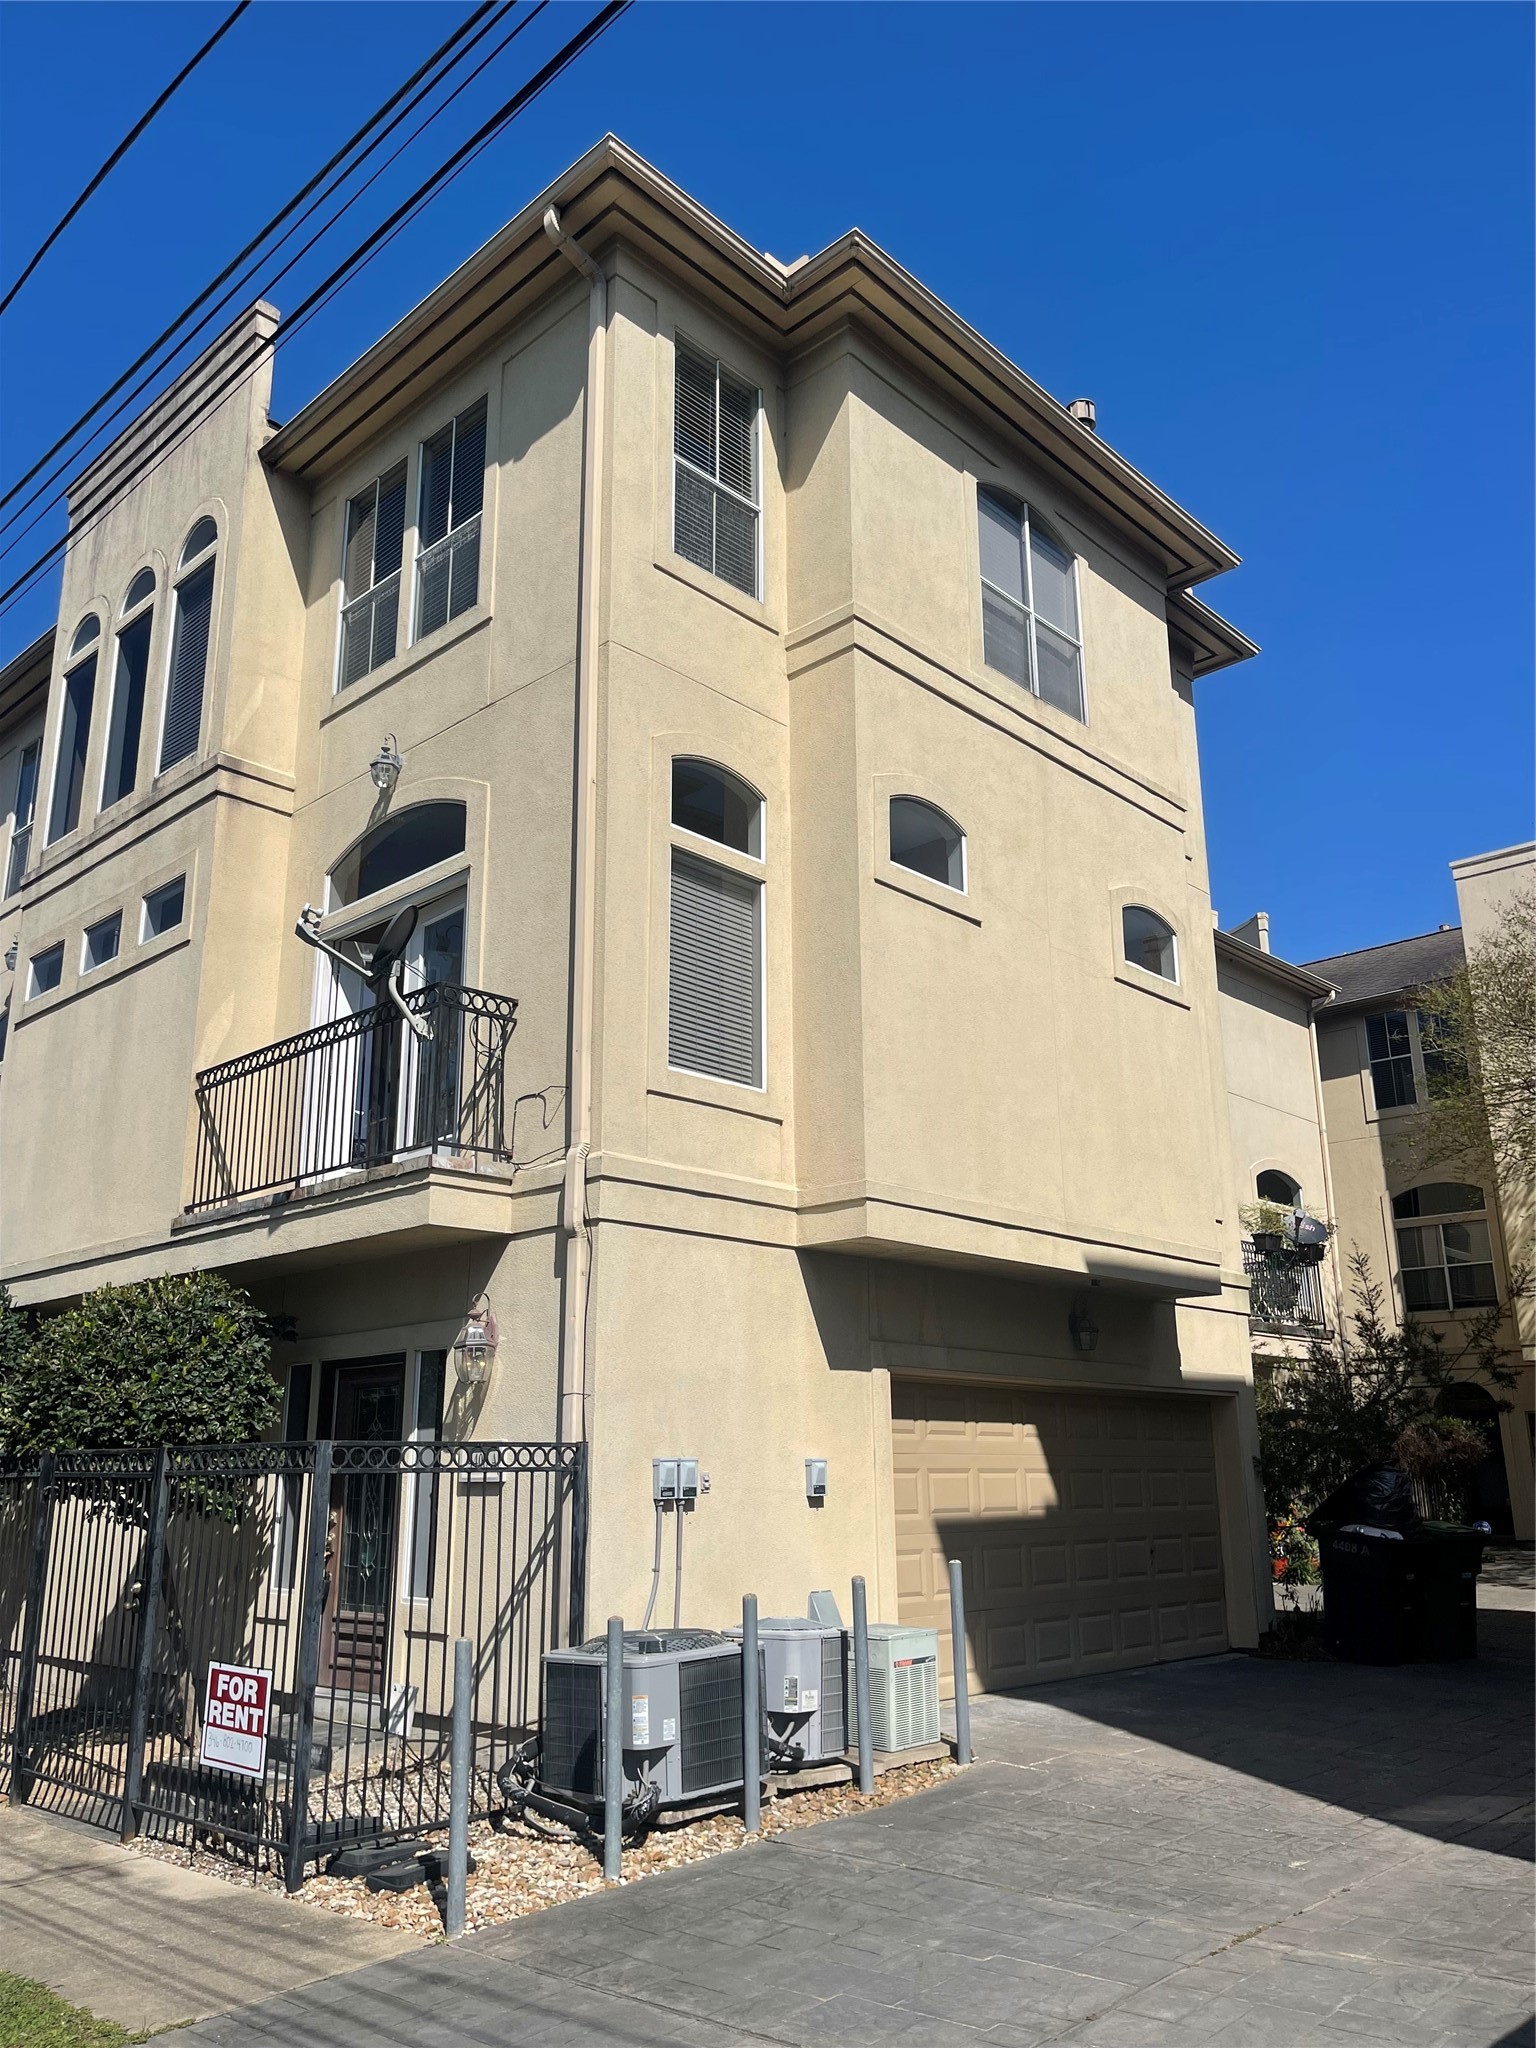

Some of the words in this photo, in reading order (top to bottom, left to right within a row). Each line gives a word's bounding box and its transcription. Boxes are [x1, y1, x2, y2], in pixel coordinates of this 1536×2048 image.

[1360, 1544, 1371, 1556] A
[217, 1674, 259, 1705] FOR
[208, 1699, 263, 1733] RENT
